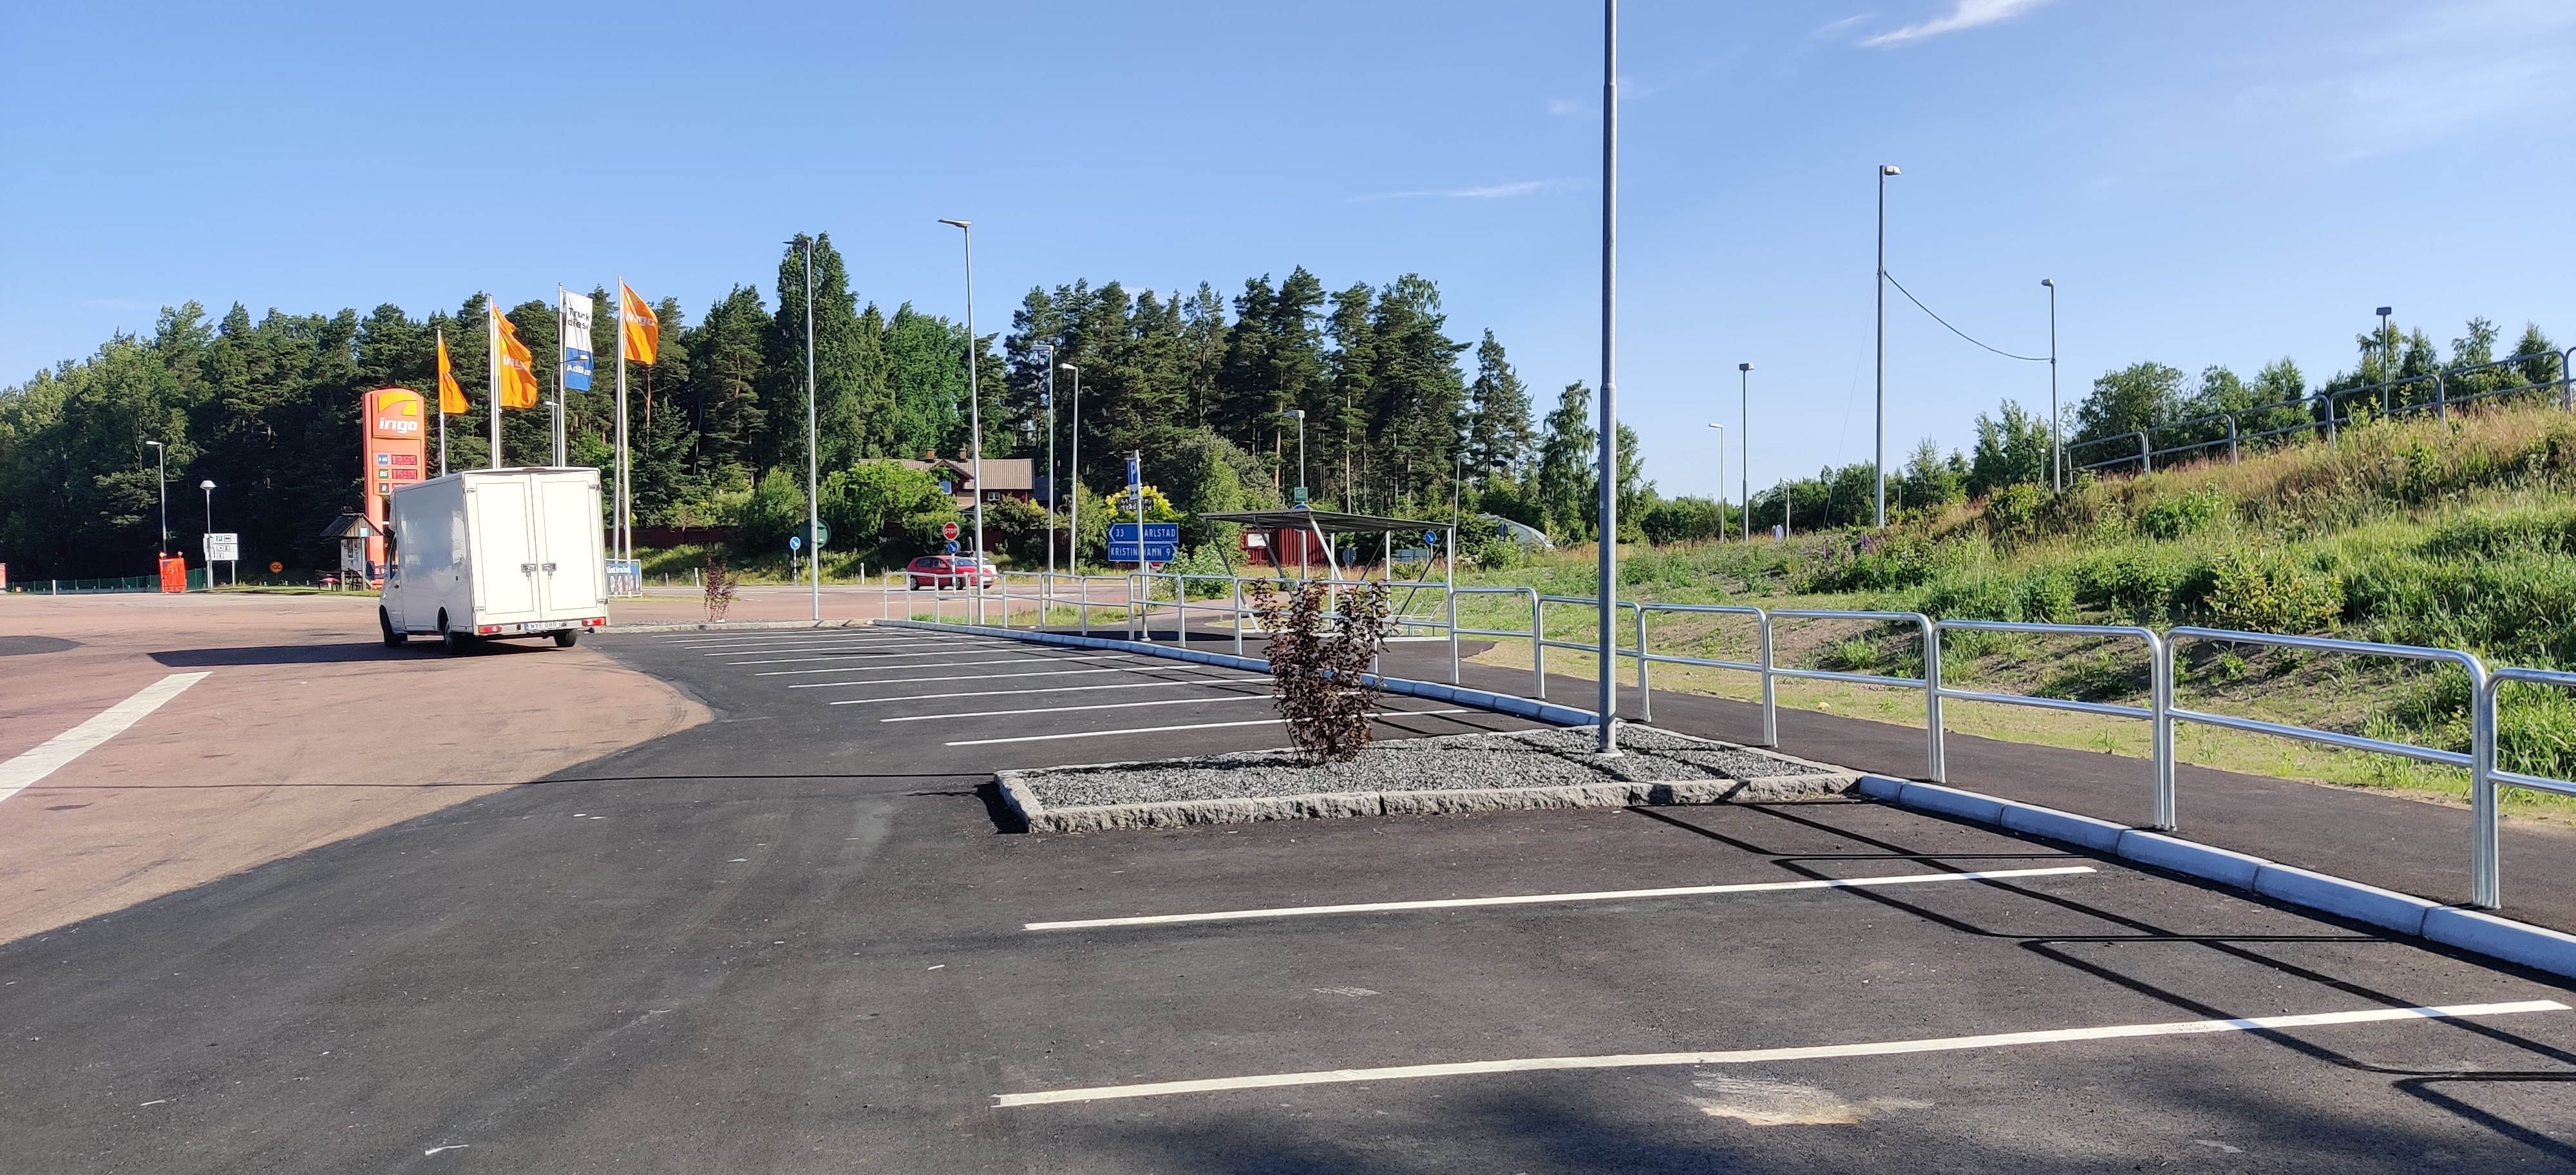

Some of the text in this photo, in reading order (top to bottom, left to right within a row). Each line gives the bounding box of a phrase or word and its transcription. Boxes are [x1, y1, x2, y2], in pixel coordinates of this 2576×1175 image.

[379, 417, 417, 434] ingo
[1130, 461, 1137, 483] P
[1115, 529, 1176, 537] 33 ARLSTAD
[1111, 547, 1171, 557] KRISTINAMN 9
